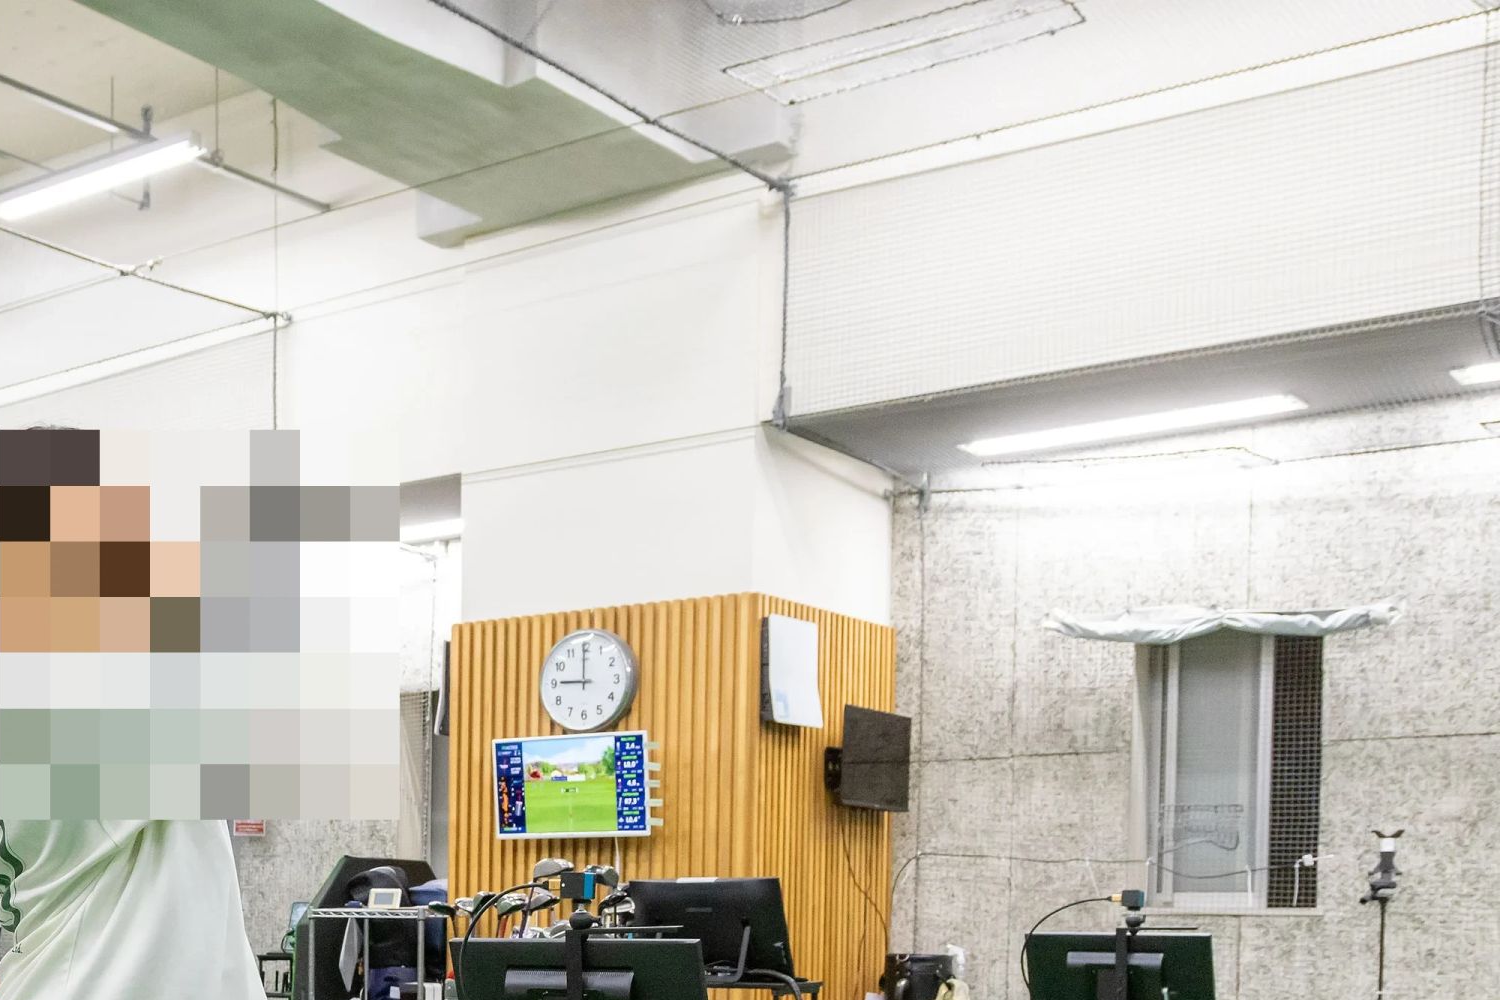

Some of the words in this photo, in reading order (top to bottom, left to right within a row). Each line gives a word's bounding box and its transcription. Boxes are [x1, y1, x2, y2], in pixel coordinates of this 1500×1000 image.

[567, 649, 575, 658] 11
[555, 661, 565, 672] 10
[609, 657, 615, 667] 2
[551, 679, 557, 689] 9
[613, 674, 620, 684] 3
[555, 696, 562, 706] 8
[608, 692, 614, 702] 4
[568, 707, 573, 717] 7
[581, 710, 587, 720] 6
[596, 705, 603, 715] 5
